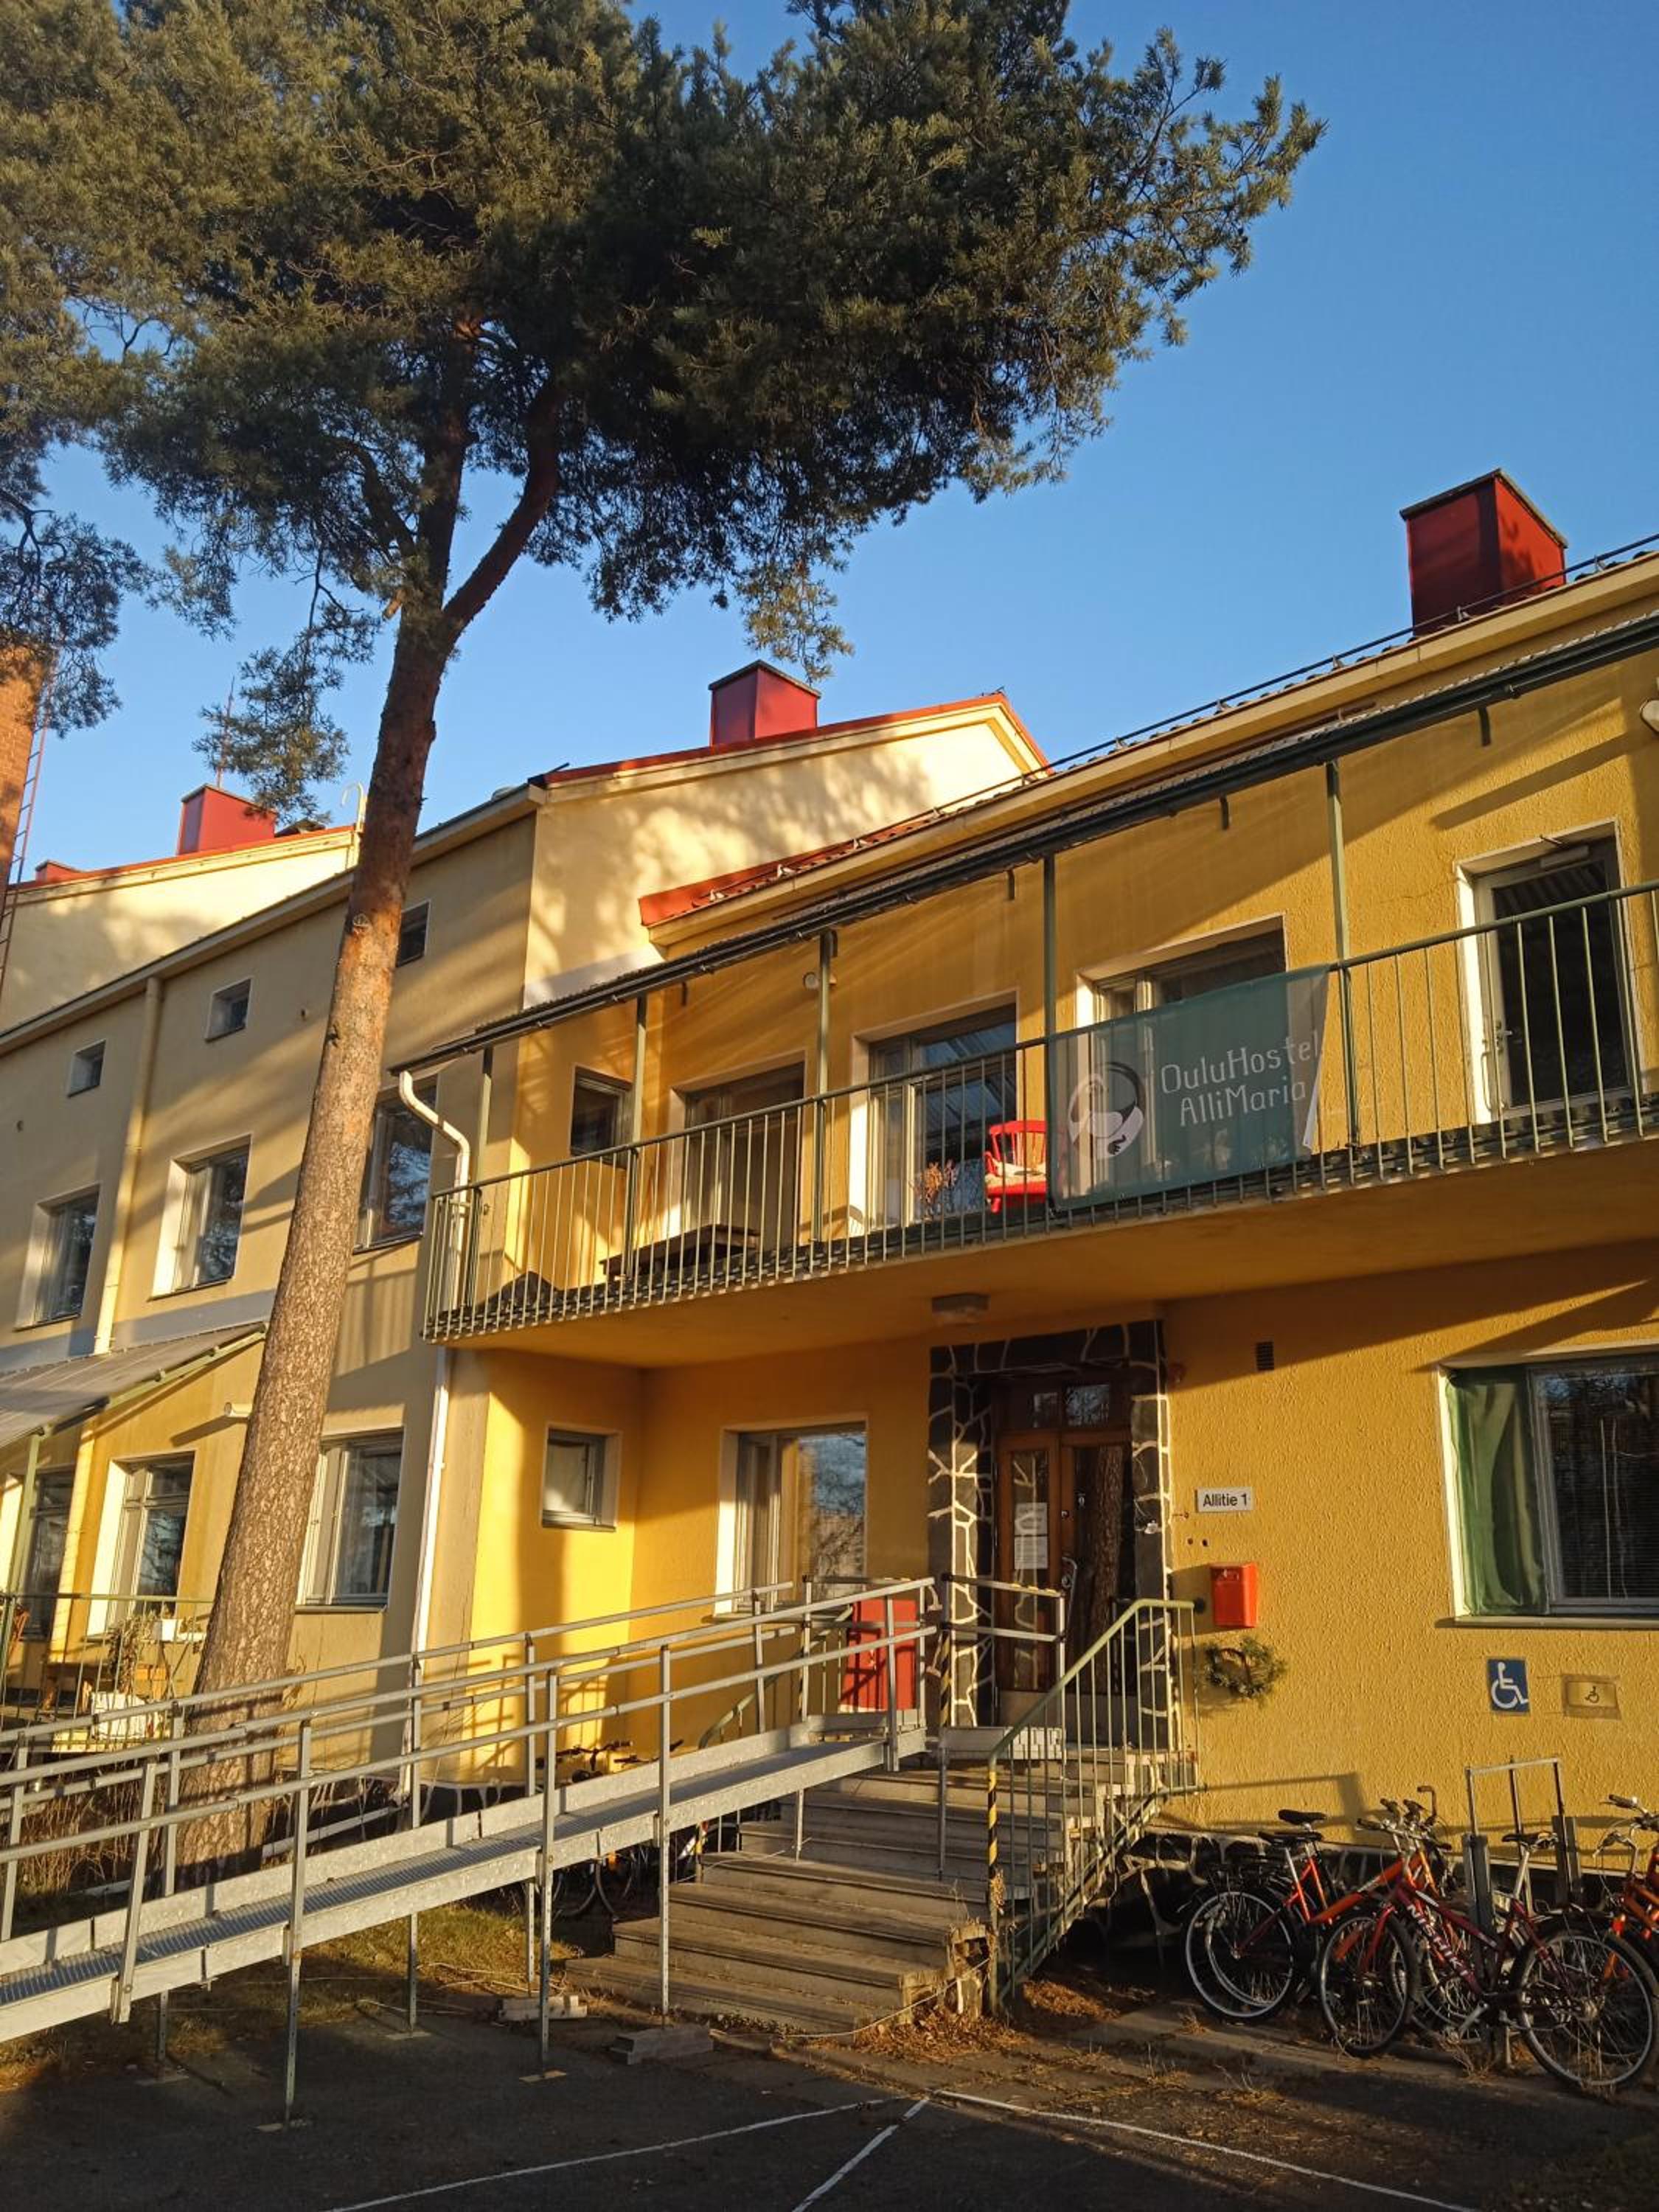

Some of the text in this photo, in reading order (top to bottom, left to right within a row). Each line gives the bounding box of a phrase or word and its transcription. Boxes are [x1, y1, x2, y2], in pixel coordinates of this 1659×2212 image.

[1161, 1030, 1319, 1093] OuluHostel
[1180, 1076, 1306, 1127] AlliMaria
[1203, 1493, 1247, 1507] Allitie 1
[1407, 1905, 1468, 1976] NISHIKI
